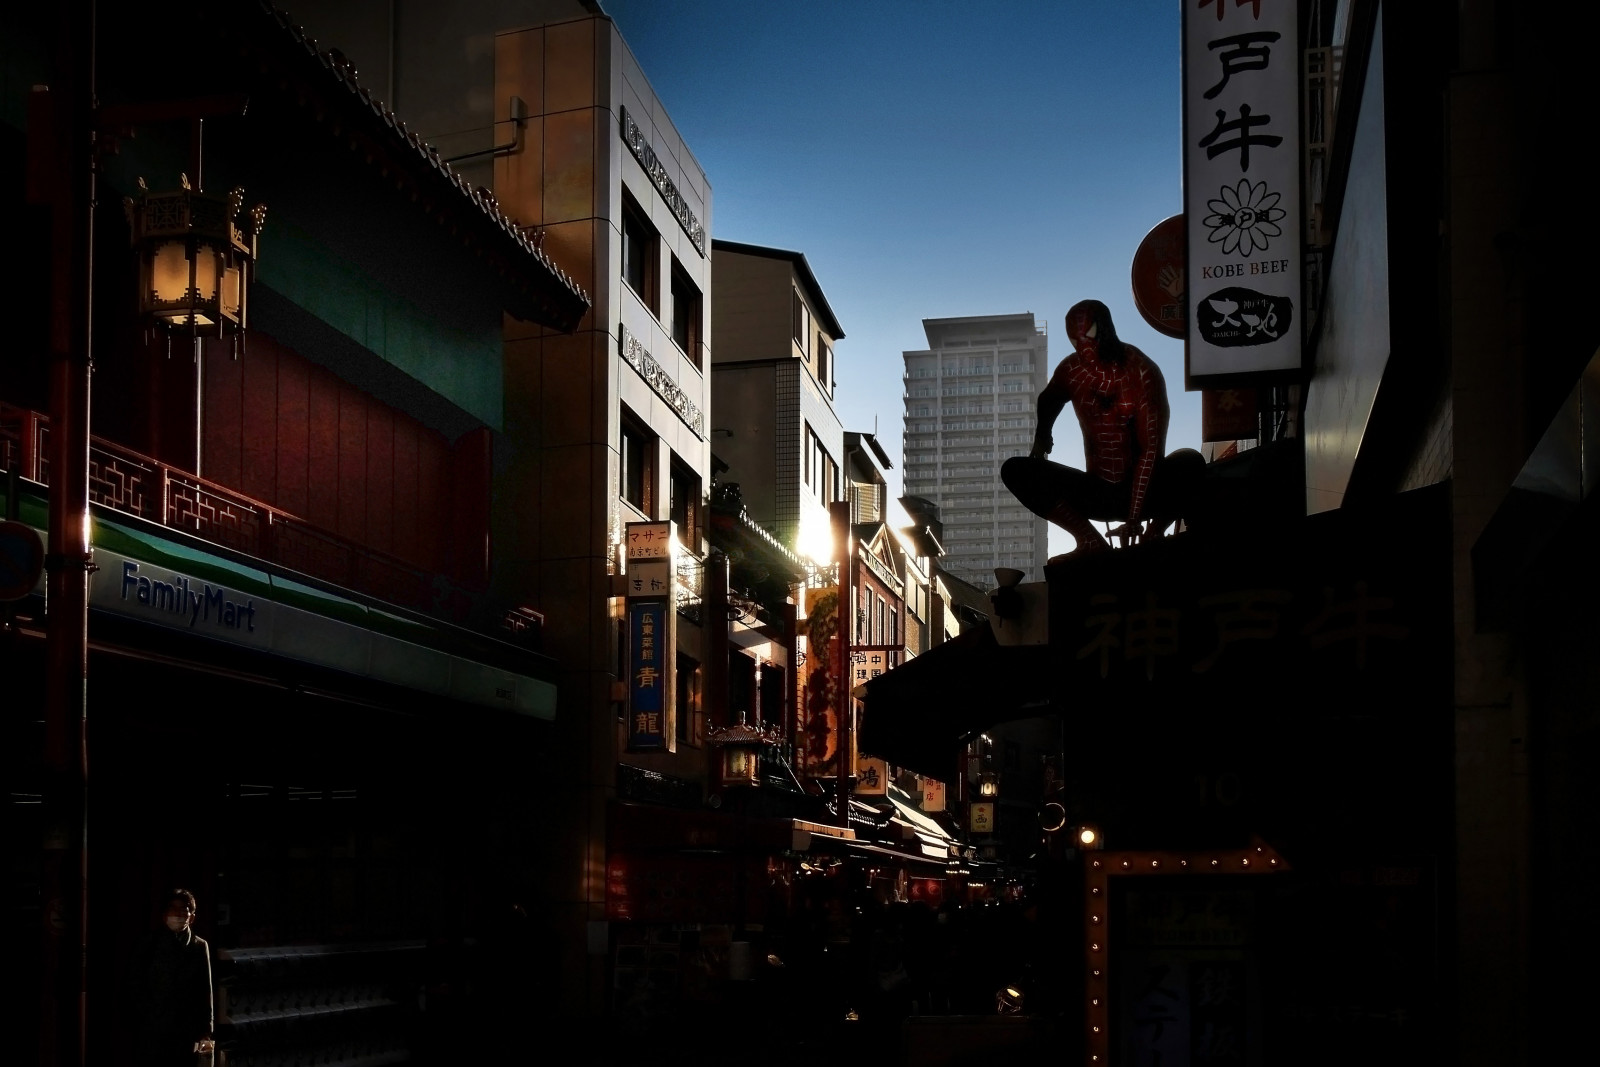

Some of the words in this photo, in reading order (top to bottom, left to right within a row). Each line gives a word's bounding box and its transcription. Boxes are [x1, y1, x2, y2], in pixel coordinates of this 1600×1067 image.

[1203, 263, 1244, 278] KOBE
[1250, 259, 1288, 275] BEEF
[121, 560, 256, 632] FamilyMart
[1074, 579, 1411, 682] 神戸牛
